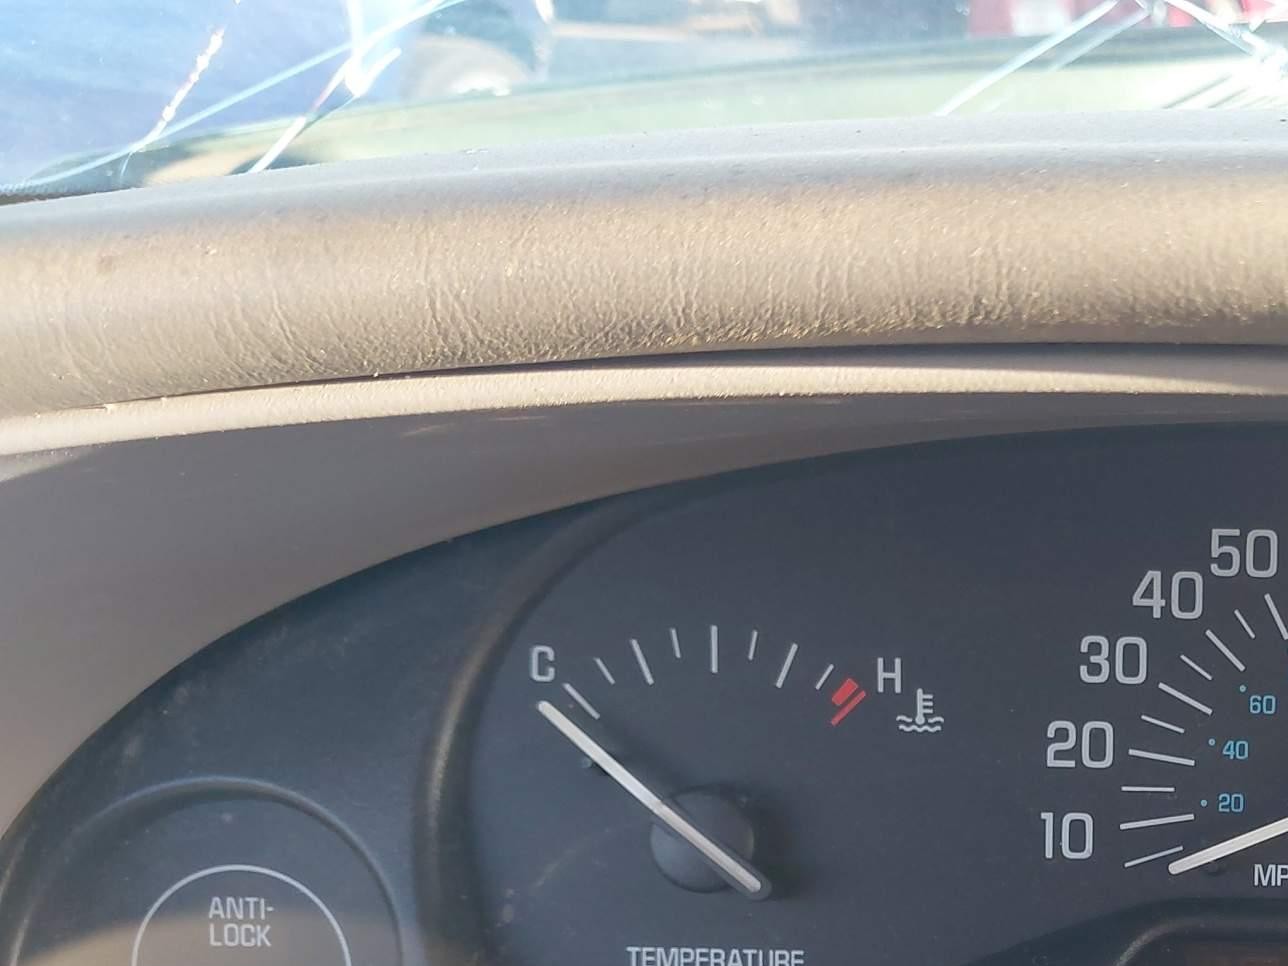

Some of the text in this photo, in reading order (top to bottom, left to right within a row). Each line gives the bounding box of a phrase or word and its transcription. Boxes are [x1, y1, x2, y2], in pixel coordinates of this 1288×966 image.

[1211, 529, 1277, 577] 50
[1133, 570, 1203, 619] 40
[531, 646, 554, 681] C
[878, 658, 901, 693] H
[1080, 636, 1147, 684] 30
[1250, 695, 1275, 714] 60
[1047, 721, 1113, 768] 20
[1223, 741, 1248, 759] 40
[1219, 794, 1243, 812] 20
[1041, 813, 1093, 859] 10
[209, 897, 273, 920] ANTI-
[210, 924, 271, 946] LOCK
